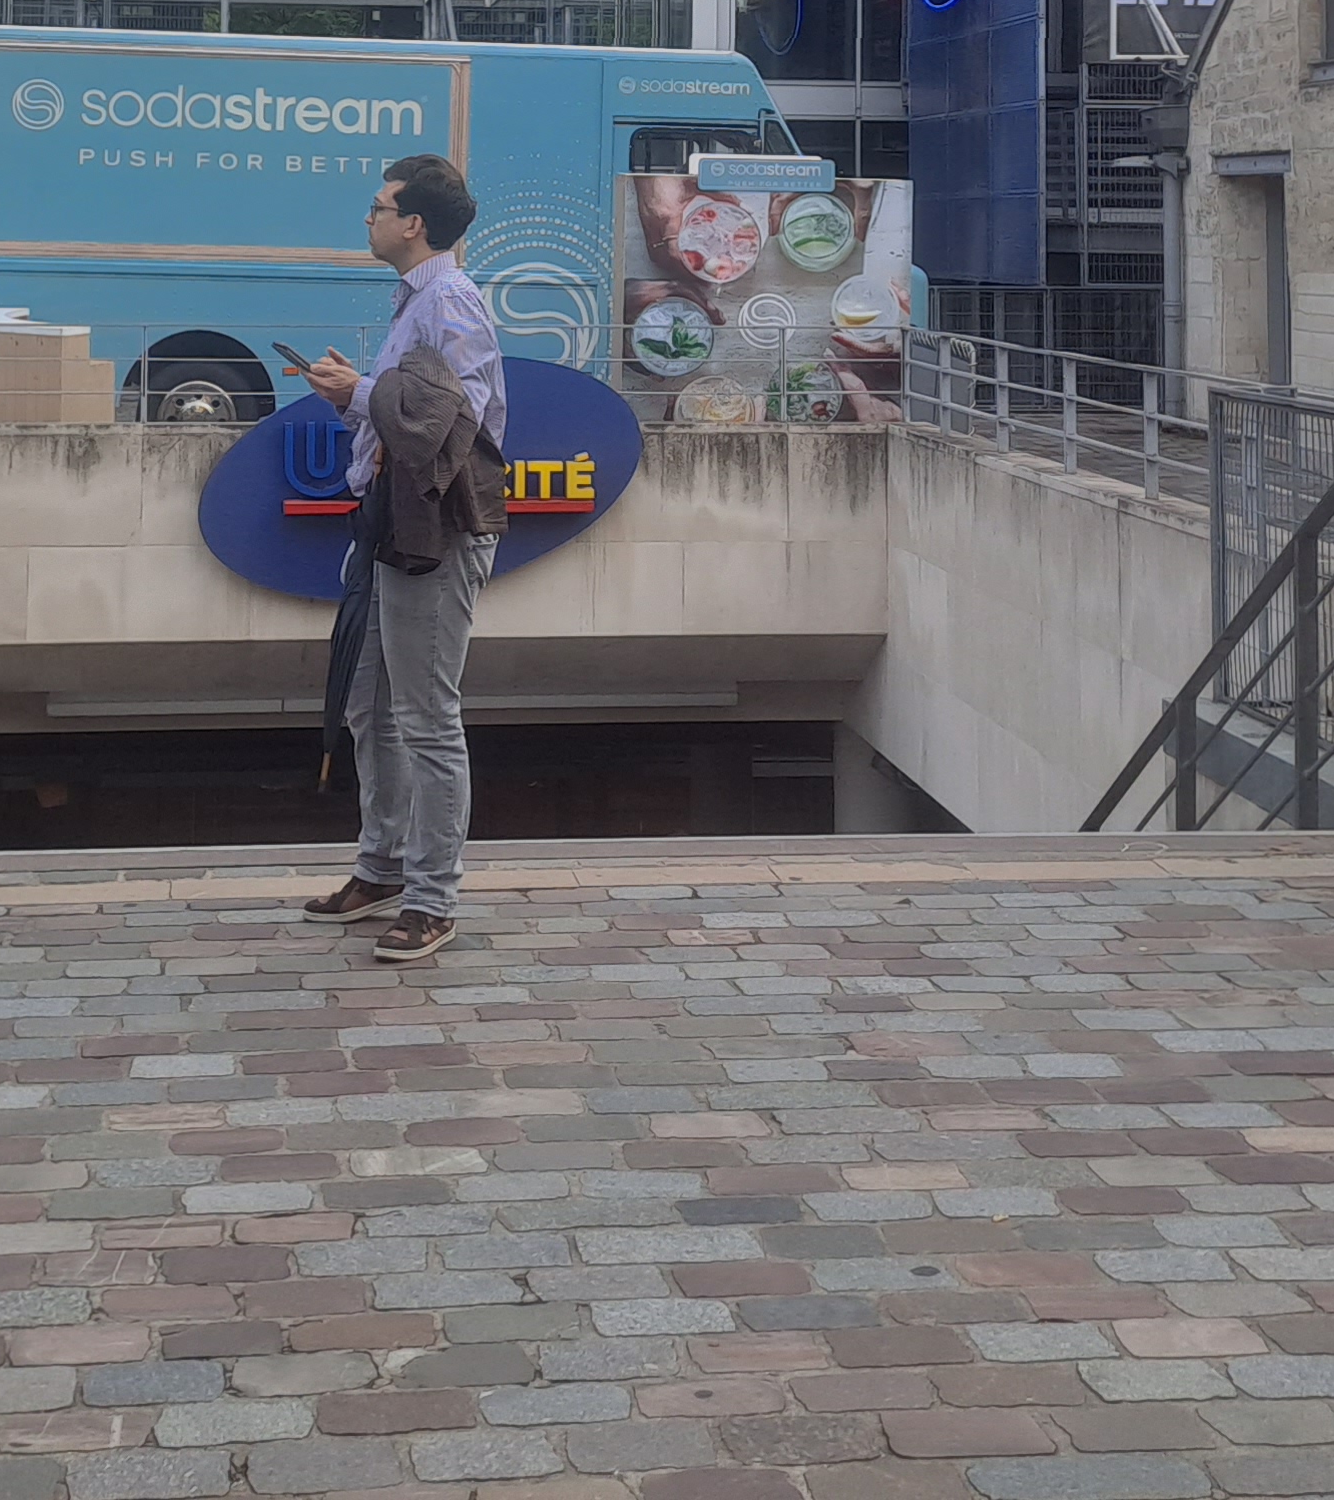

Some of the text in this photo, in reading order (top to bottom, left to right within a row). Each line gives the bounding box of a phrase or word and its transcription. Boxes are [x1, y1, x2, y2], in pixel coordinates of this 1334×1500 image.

[640, 77, 750, 96] sodastream
[80, 85, 423, 136] sodastream
[78, 148, 173, 168] PUSH
[197, 152, 263, 171] FOR
[728, 163, 821, 177] sodastream
